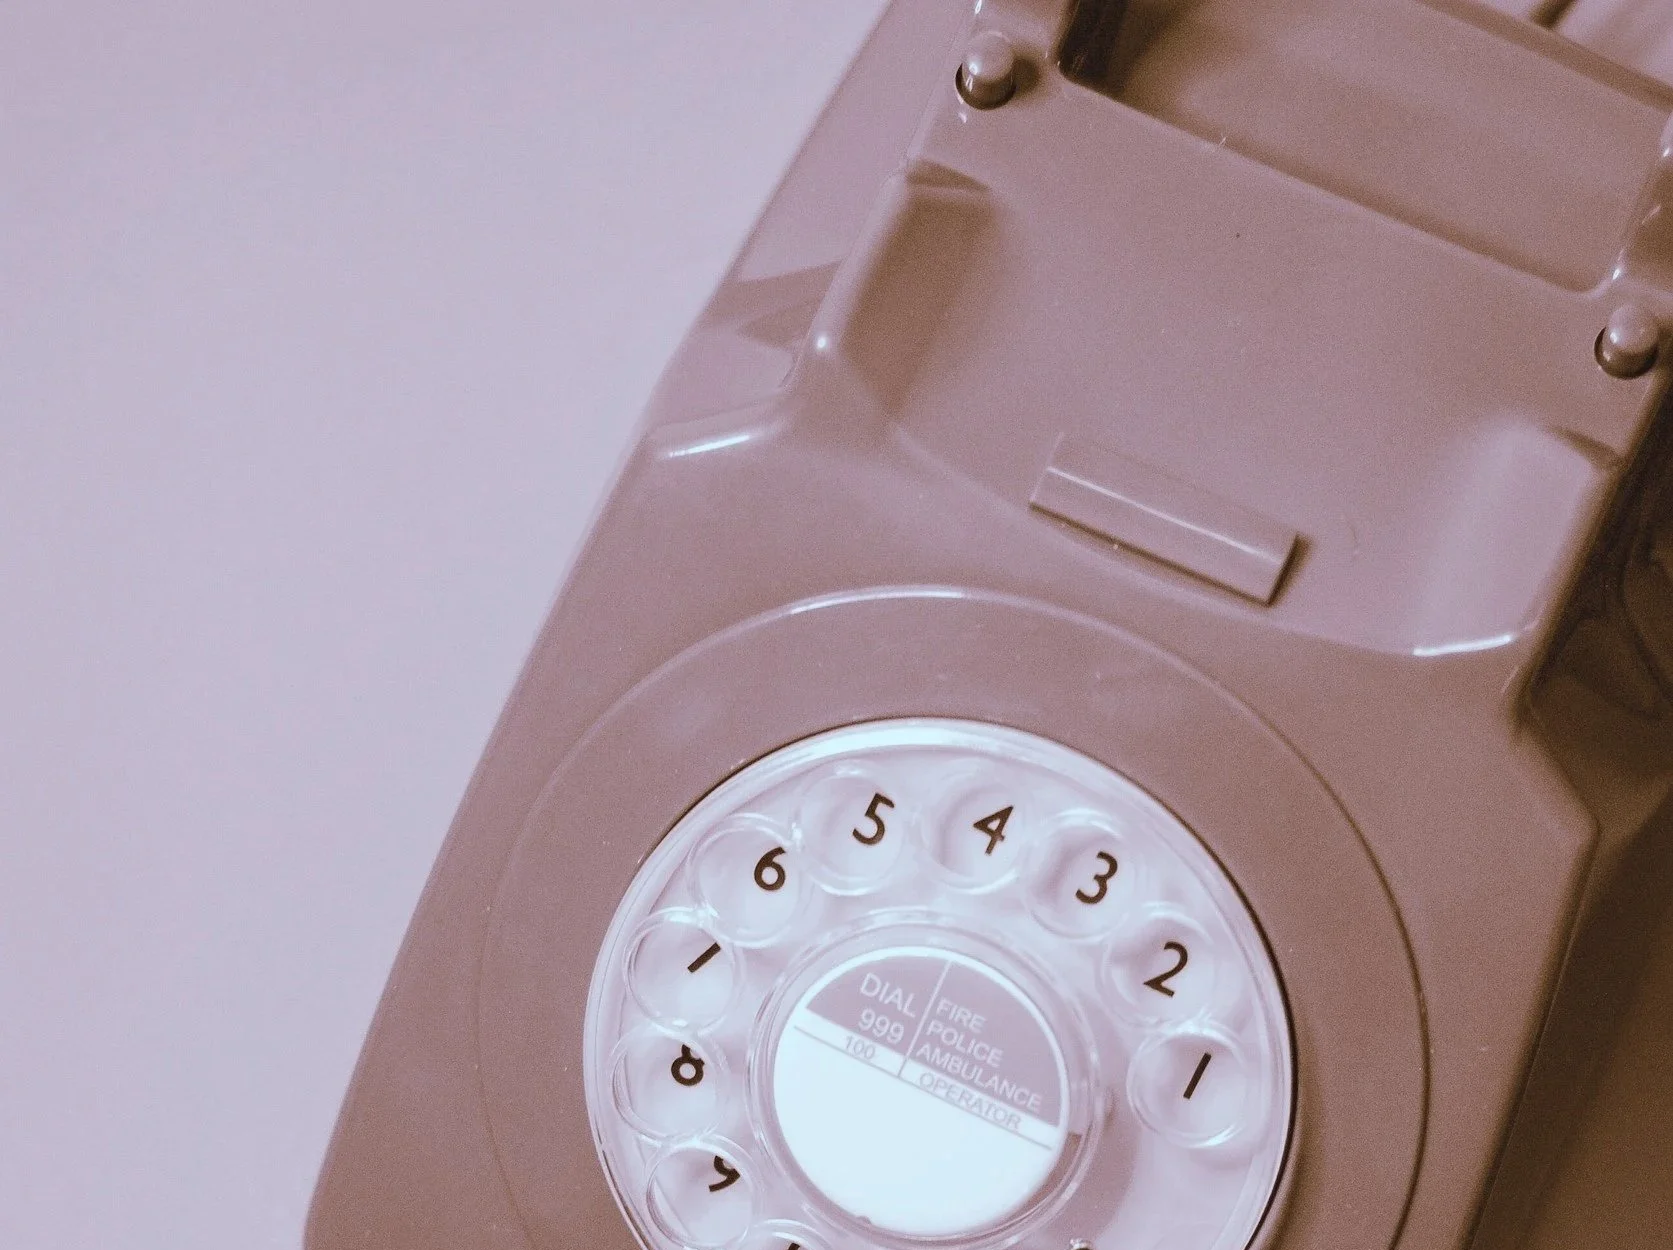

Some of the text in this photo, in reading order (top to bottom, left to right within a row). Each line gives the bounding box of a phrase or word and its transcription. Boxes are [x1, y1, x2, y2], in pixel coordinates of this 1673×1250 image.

[853, 792, 895, 846] 5
[973, 805, 1014, 855] 4
[753, 846, 787, 892] 6
[1075, 851, 1118, 905] 3
[1143, 941, 1189, 998] 2
[860, 972, 917, 1018] DIAL
[936, 996, 986, 1033] FIRE
[844, 1034, 876, 1061] 100
[858, 1008, 905, 1044] 999
[926, 1020, 1004, 1068] POLICE
[916, 1043, 1042, 1112] AMBULANCE
[918, 1070, 1022, 1130] OPERATOR
[1183, 1052, 1212, 1100] 1
